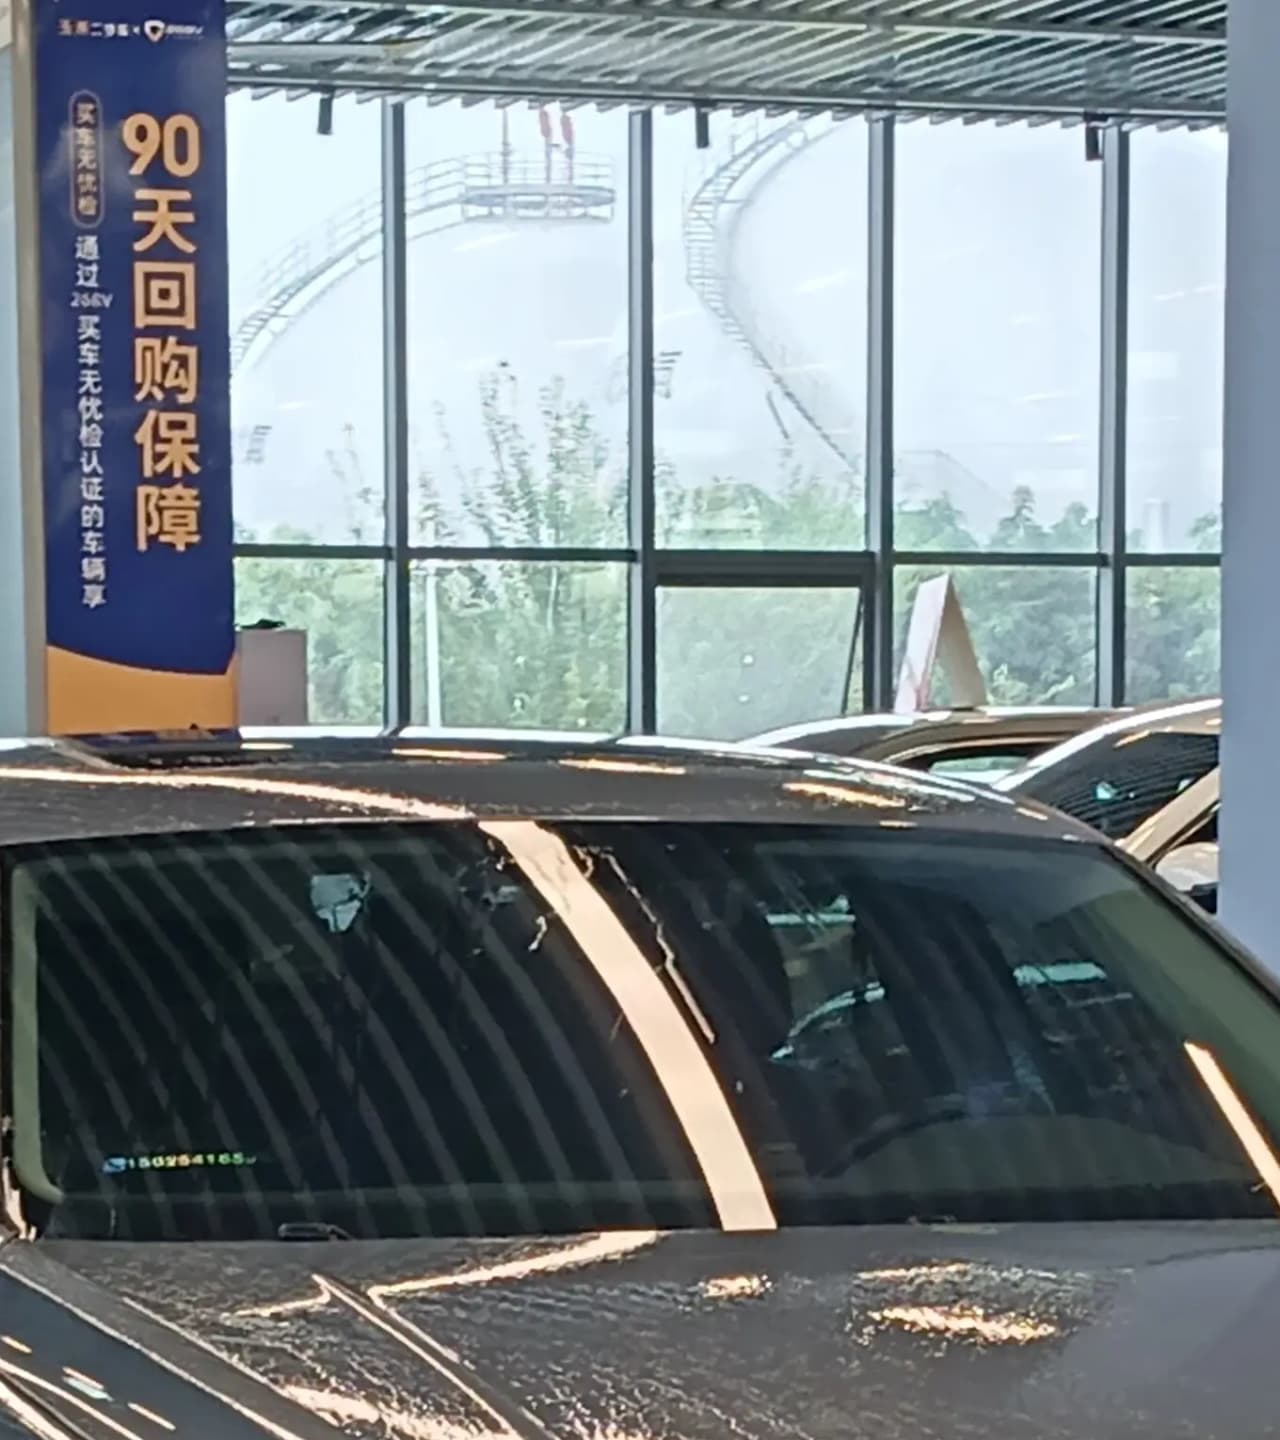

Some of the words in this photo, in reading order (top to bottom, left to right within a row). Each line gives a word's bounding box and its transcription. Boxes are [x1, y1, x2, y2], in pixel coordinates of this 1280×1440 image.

[122, 113, 201, 552] 90天回购保障
